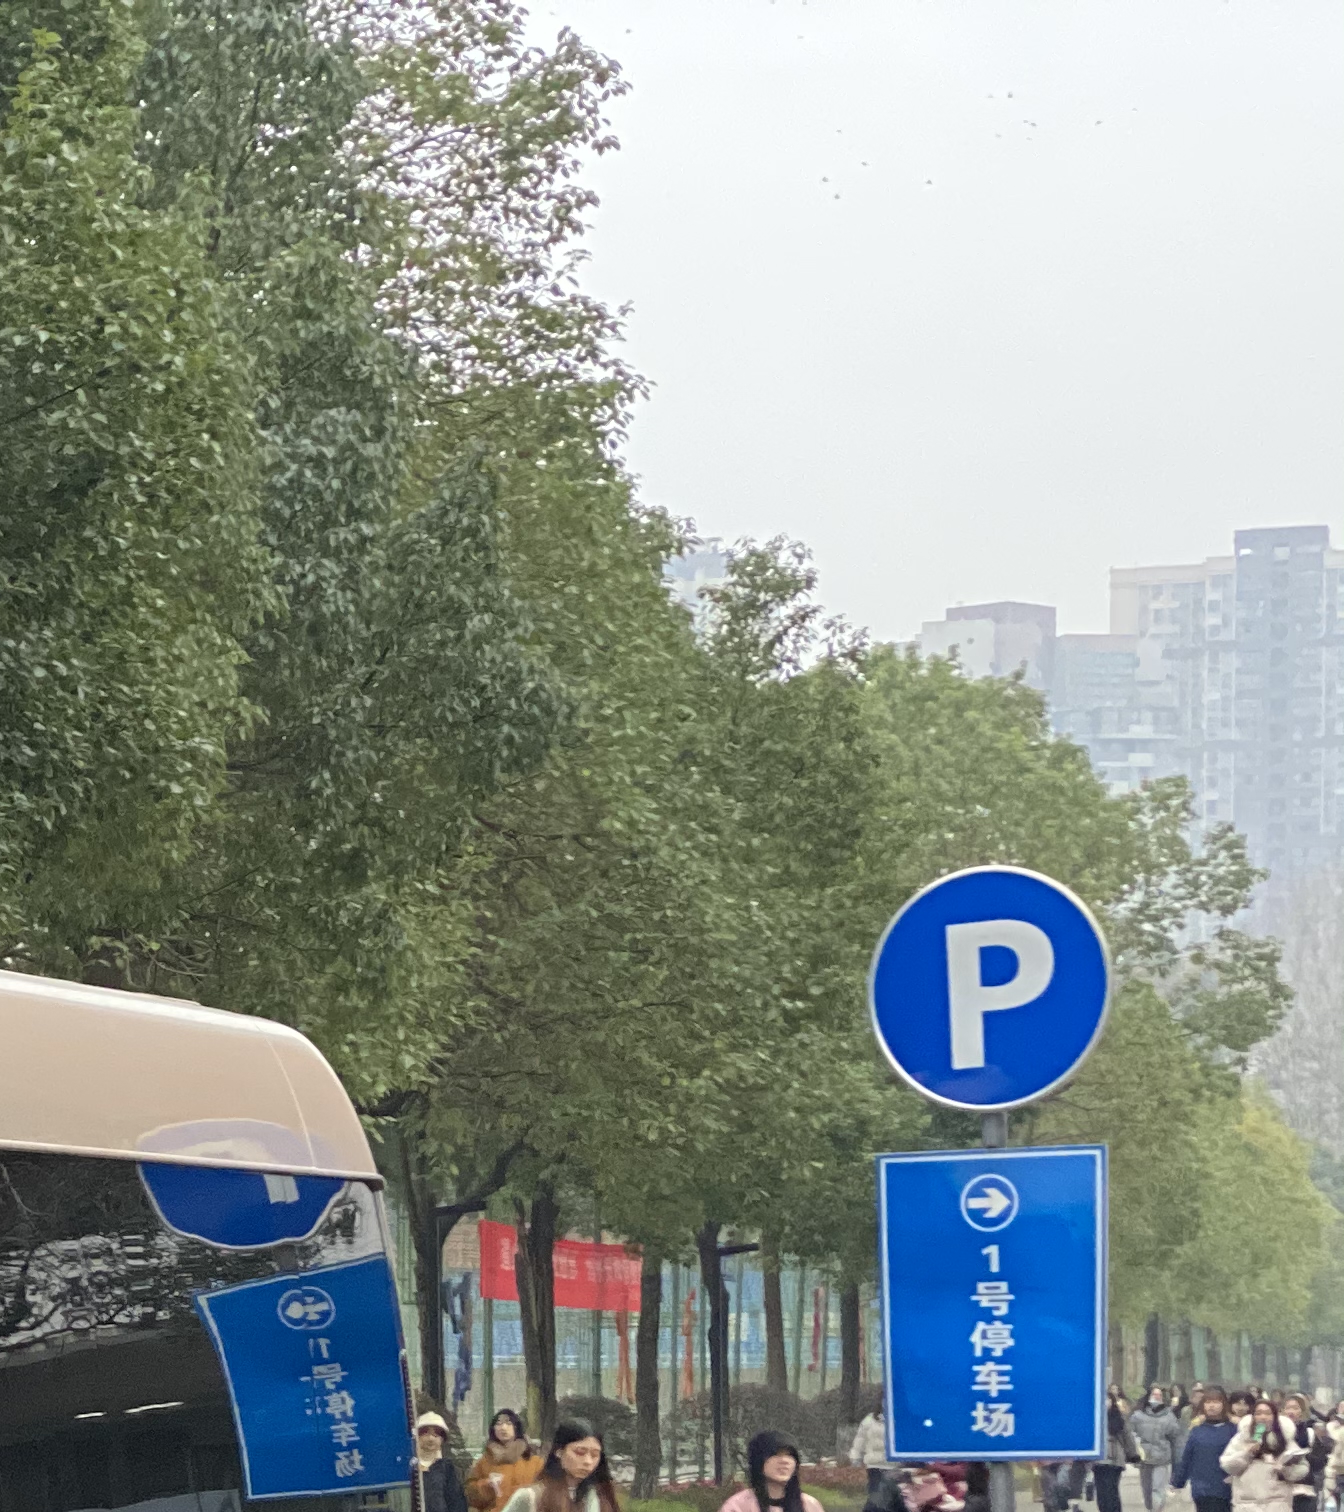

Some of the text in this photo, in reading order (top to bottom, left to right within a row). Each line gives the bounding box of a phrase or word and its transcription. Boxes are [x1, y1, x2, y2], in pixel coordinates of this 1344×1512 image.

[945, 919, 1055, 1071] P
[969, 1244, 1016, 1438] 1号停车场
